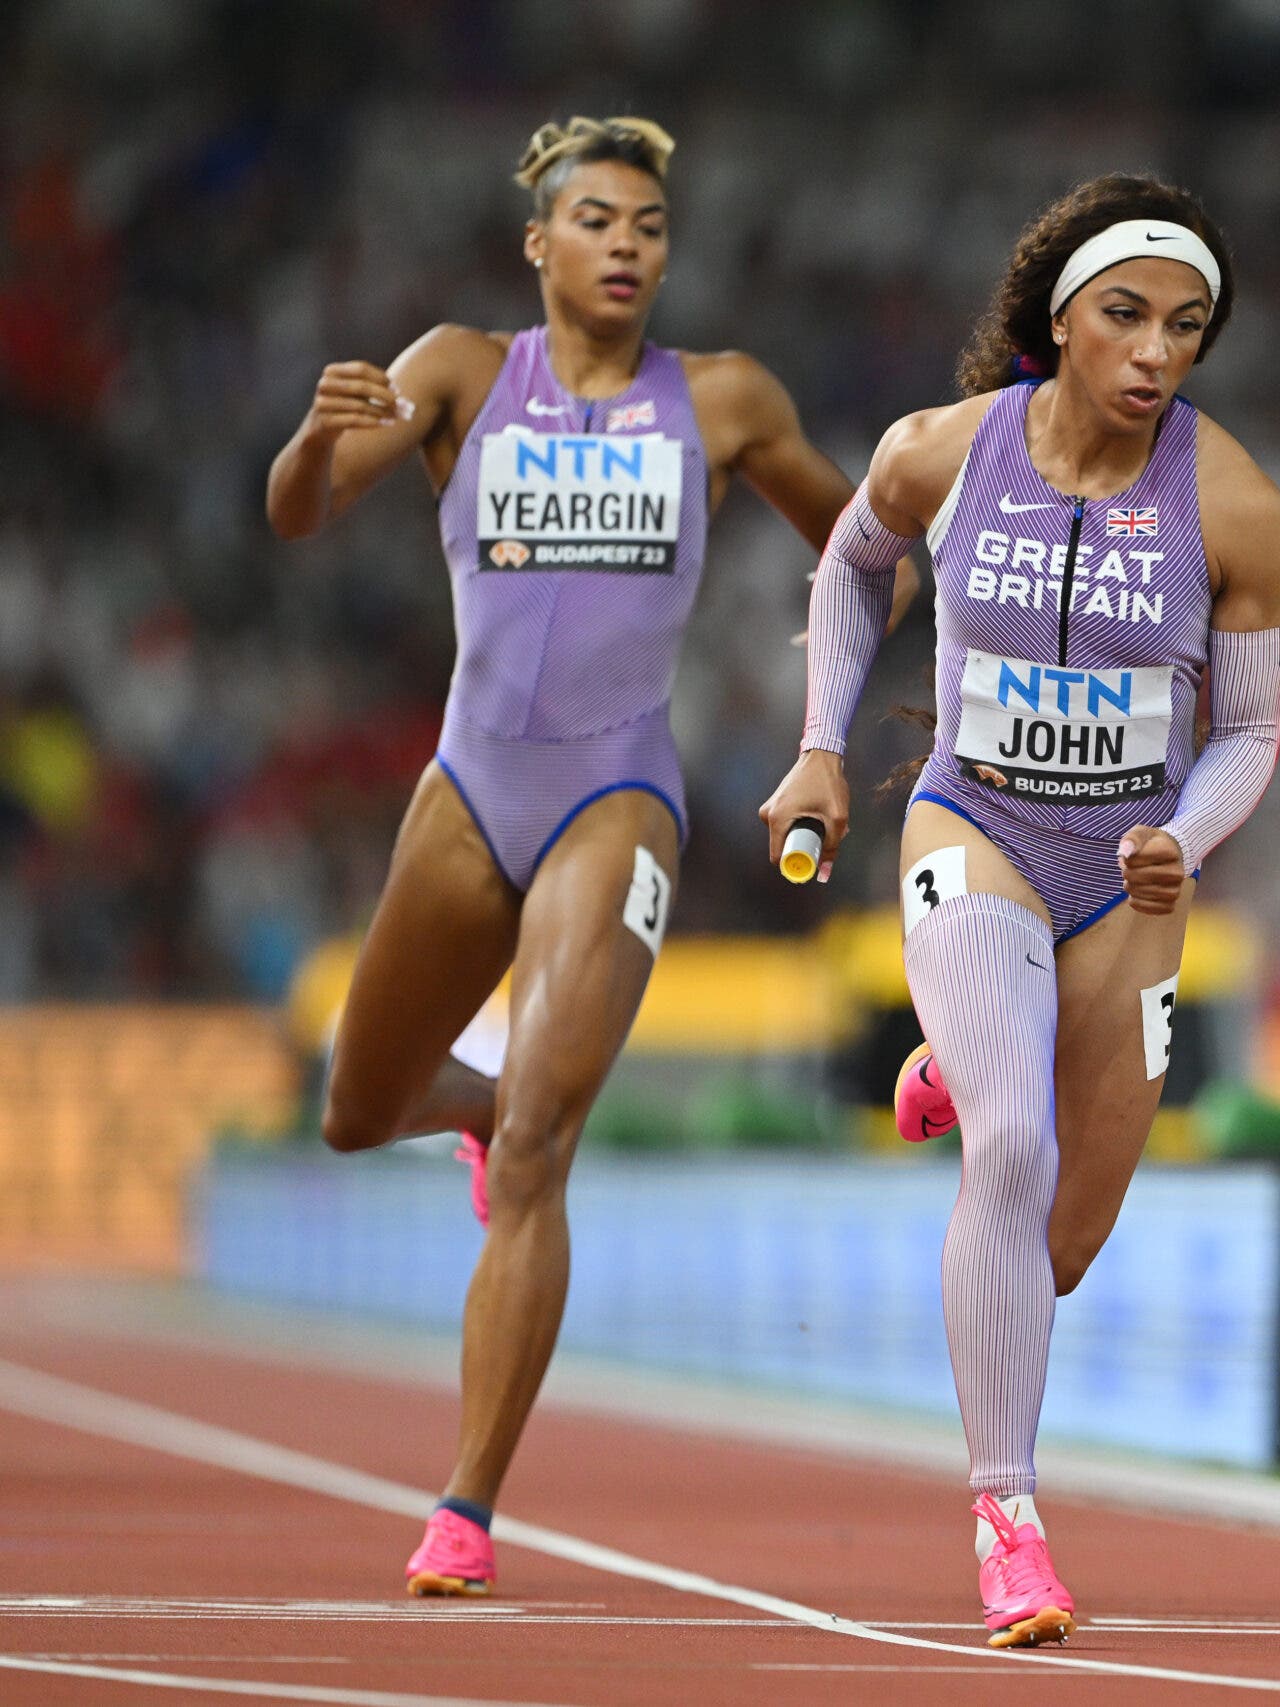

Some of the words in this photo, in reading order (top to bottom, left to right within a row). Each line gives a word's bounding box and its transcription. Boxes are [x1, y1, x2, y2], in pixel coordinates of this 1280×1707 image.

[517, 439, 642, 481] NTN
[490, 492, 665, 531] YEARGIN
[535, 544, 641, 563] BUDAPEST
[642, 546, 666, 565] 23
[976, 530, 1164, 584] GREAT
[966, 567, 1164, 624] BRITAIN
[997, 660, 1132, 718] NTN
[998, 718, 1125, 766] JOHN
[1015, 776, 1128, 797] BUDAPEST
[1130, 774, 1153, 791] 23
